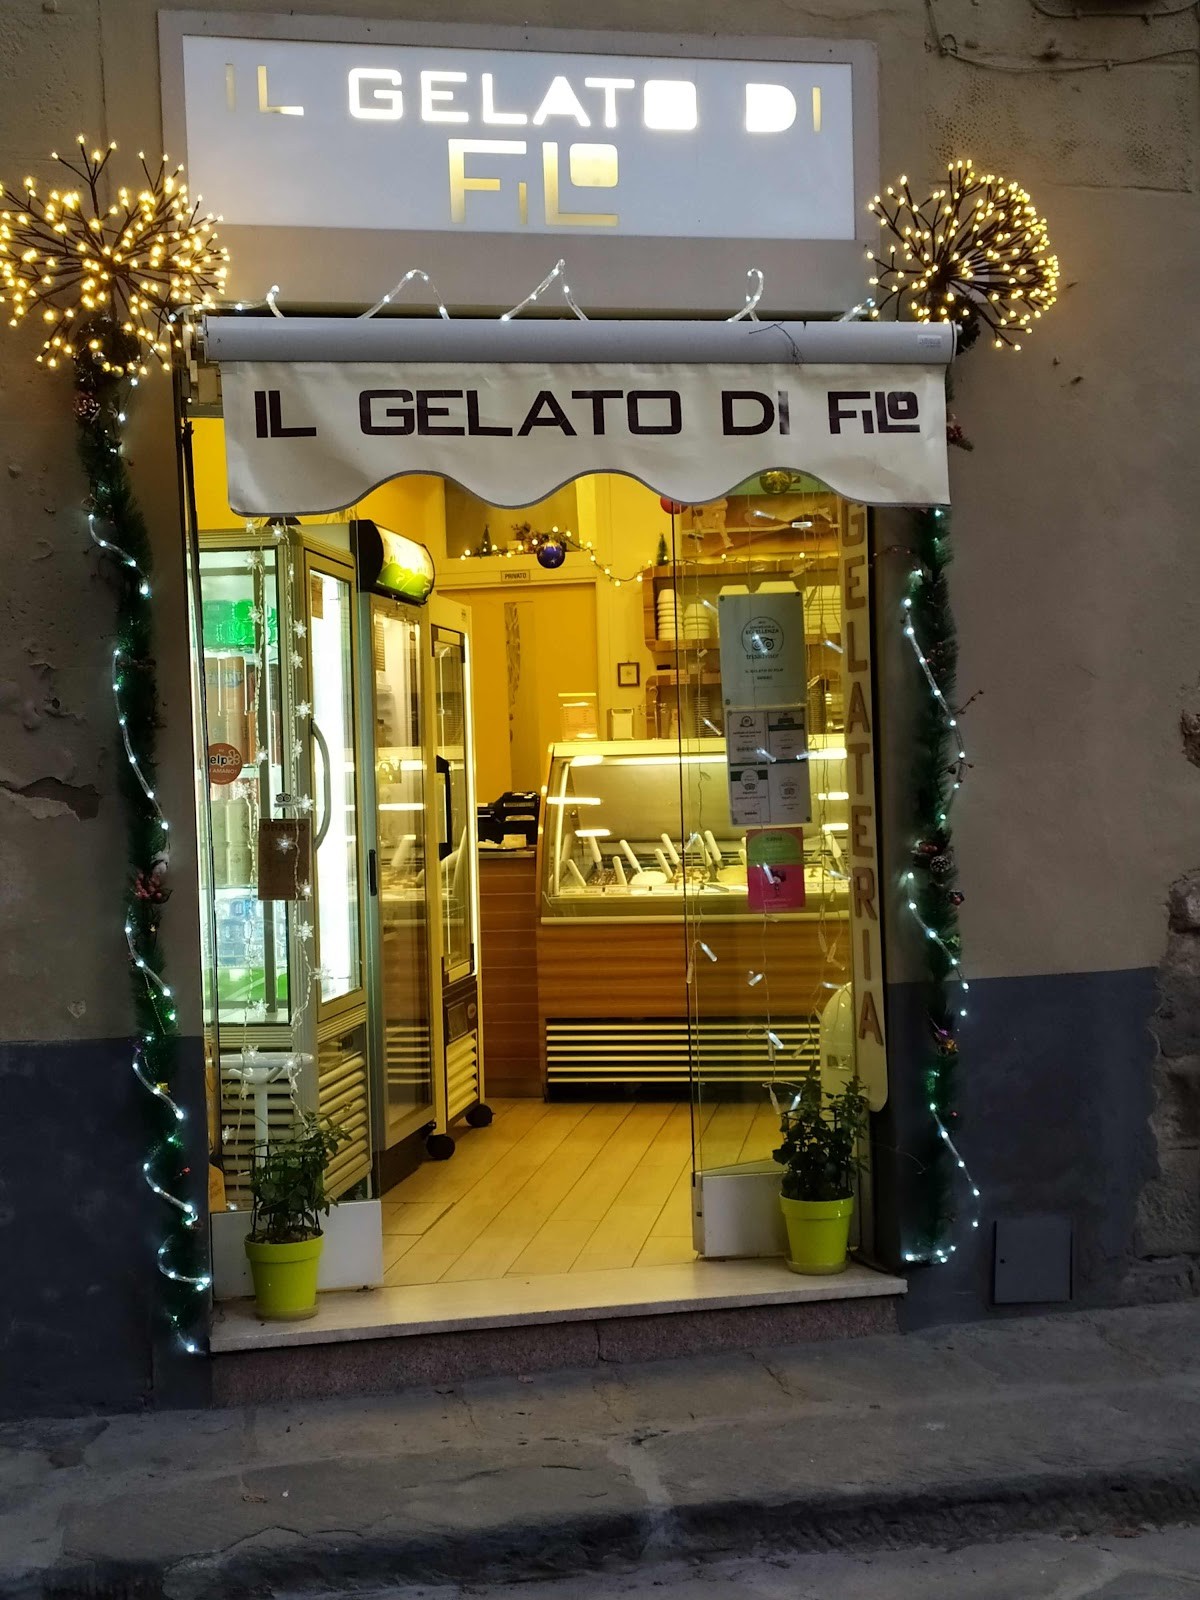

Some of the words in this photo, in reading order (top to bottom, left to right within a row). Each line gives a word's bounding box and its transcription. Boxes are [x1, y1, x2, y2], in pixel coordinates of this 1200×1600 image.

[225, 63, 304, 116] IL
[347, 67, 698, 131] GELATO
[744, 83, 822, 133] DI
[254, 390, 318, 439] IL
[358, 389, 683, 437] GELATO
[721, 390, 790, 436] DI
[504, 572, 527, 580] PRIVATO
[209, 754, 228, 767] elp
[842, 500, 884, 1046] GELATERIA
